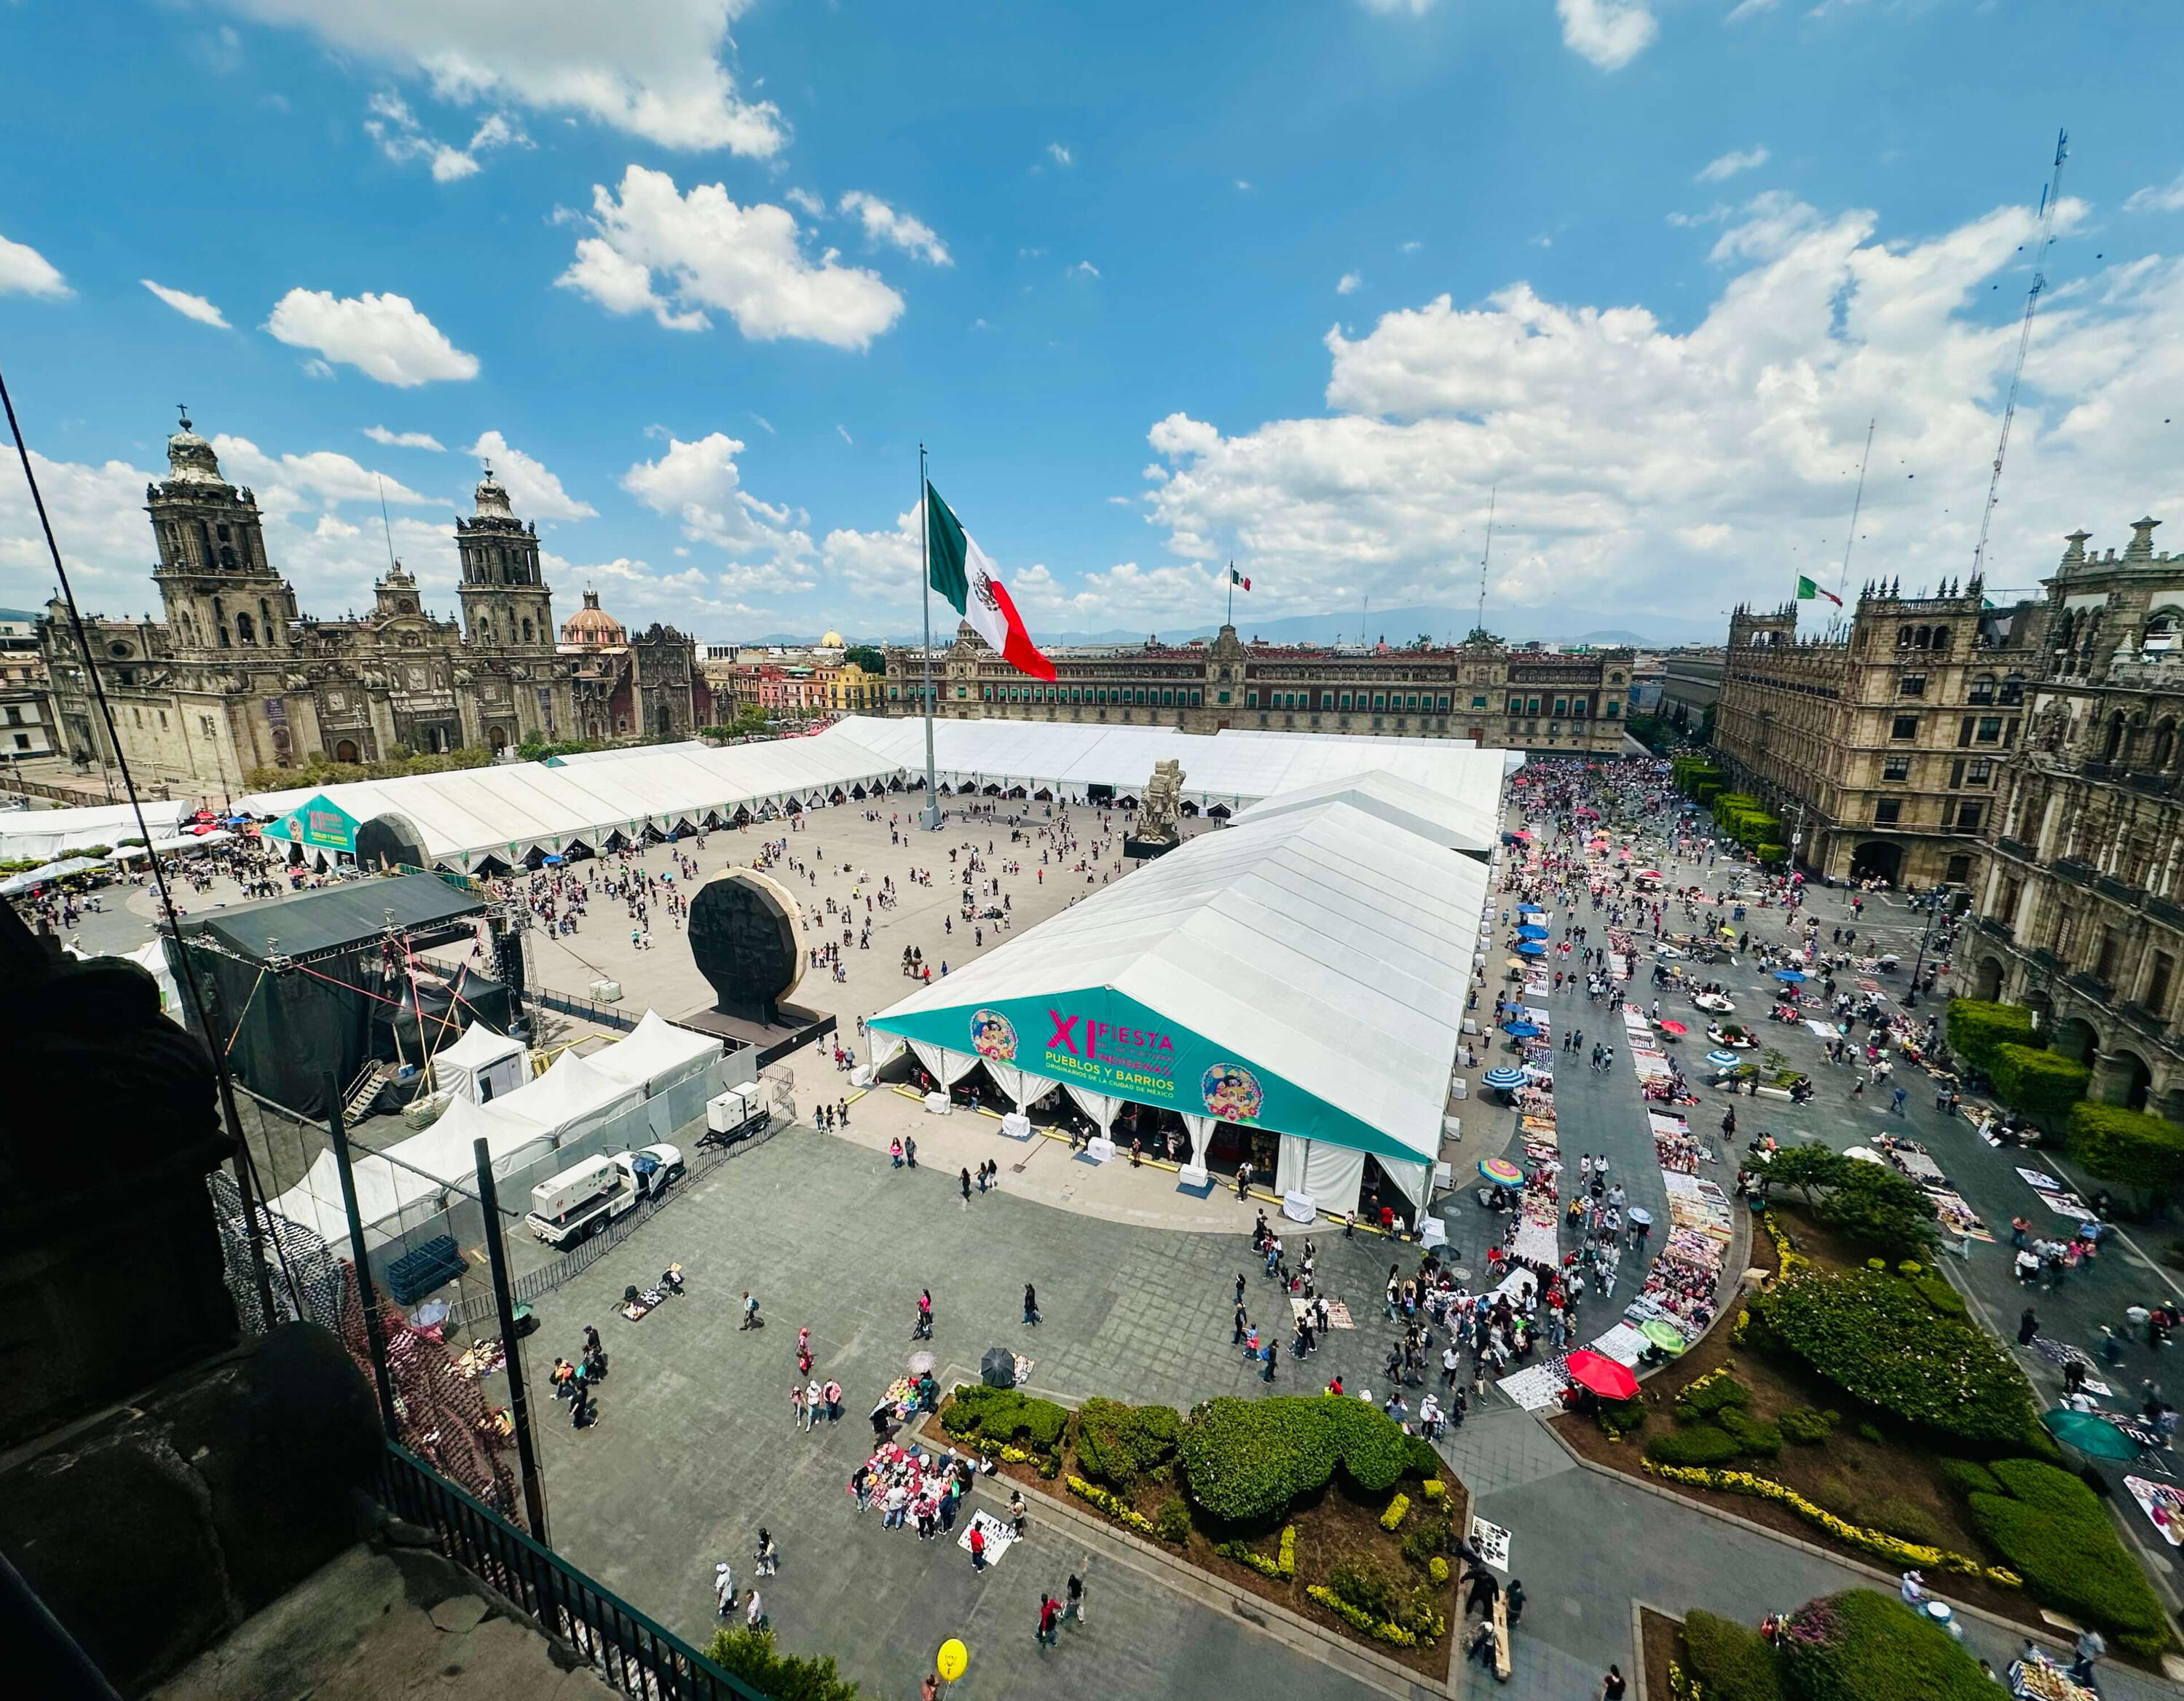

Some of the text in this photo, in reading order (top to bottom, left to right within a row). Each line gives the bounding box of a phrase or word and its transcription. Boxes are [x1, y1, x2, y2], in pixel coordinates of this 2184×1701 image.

[1047, 1009, 1096, 1059] XI
[1099, 1022, 1174, 1052] FIESTA
[1046, 1051, 1100, 1074] PUEBLOS
[1104, 1067, 1112, 1077] Y
[1116, 1070, 1174, 1091] BARRIOS
[1046, 1062, 1087, 1078] ORIGINARIOS
[1098, 1076, 1107, 1084] LA
[1109, 1080, 1134, 1090] CIUDAD
[1146, 1088, 1174, 1098] MÉXICO
